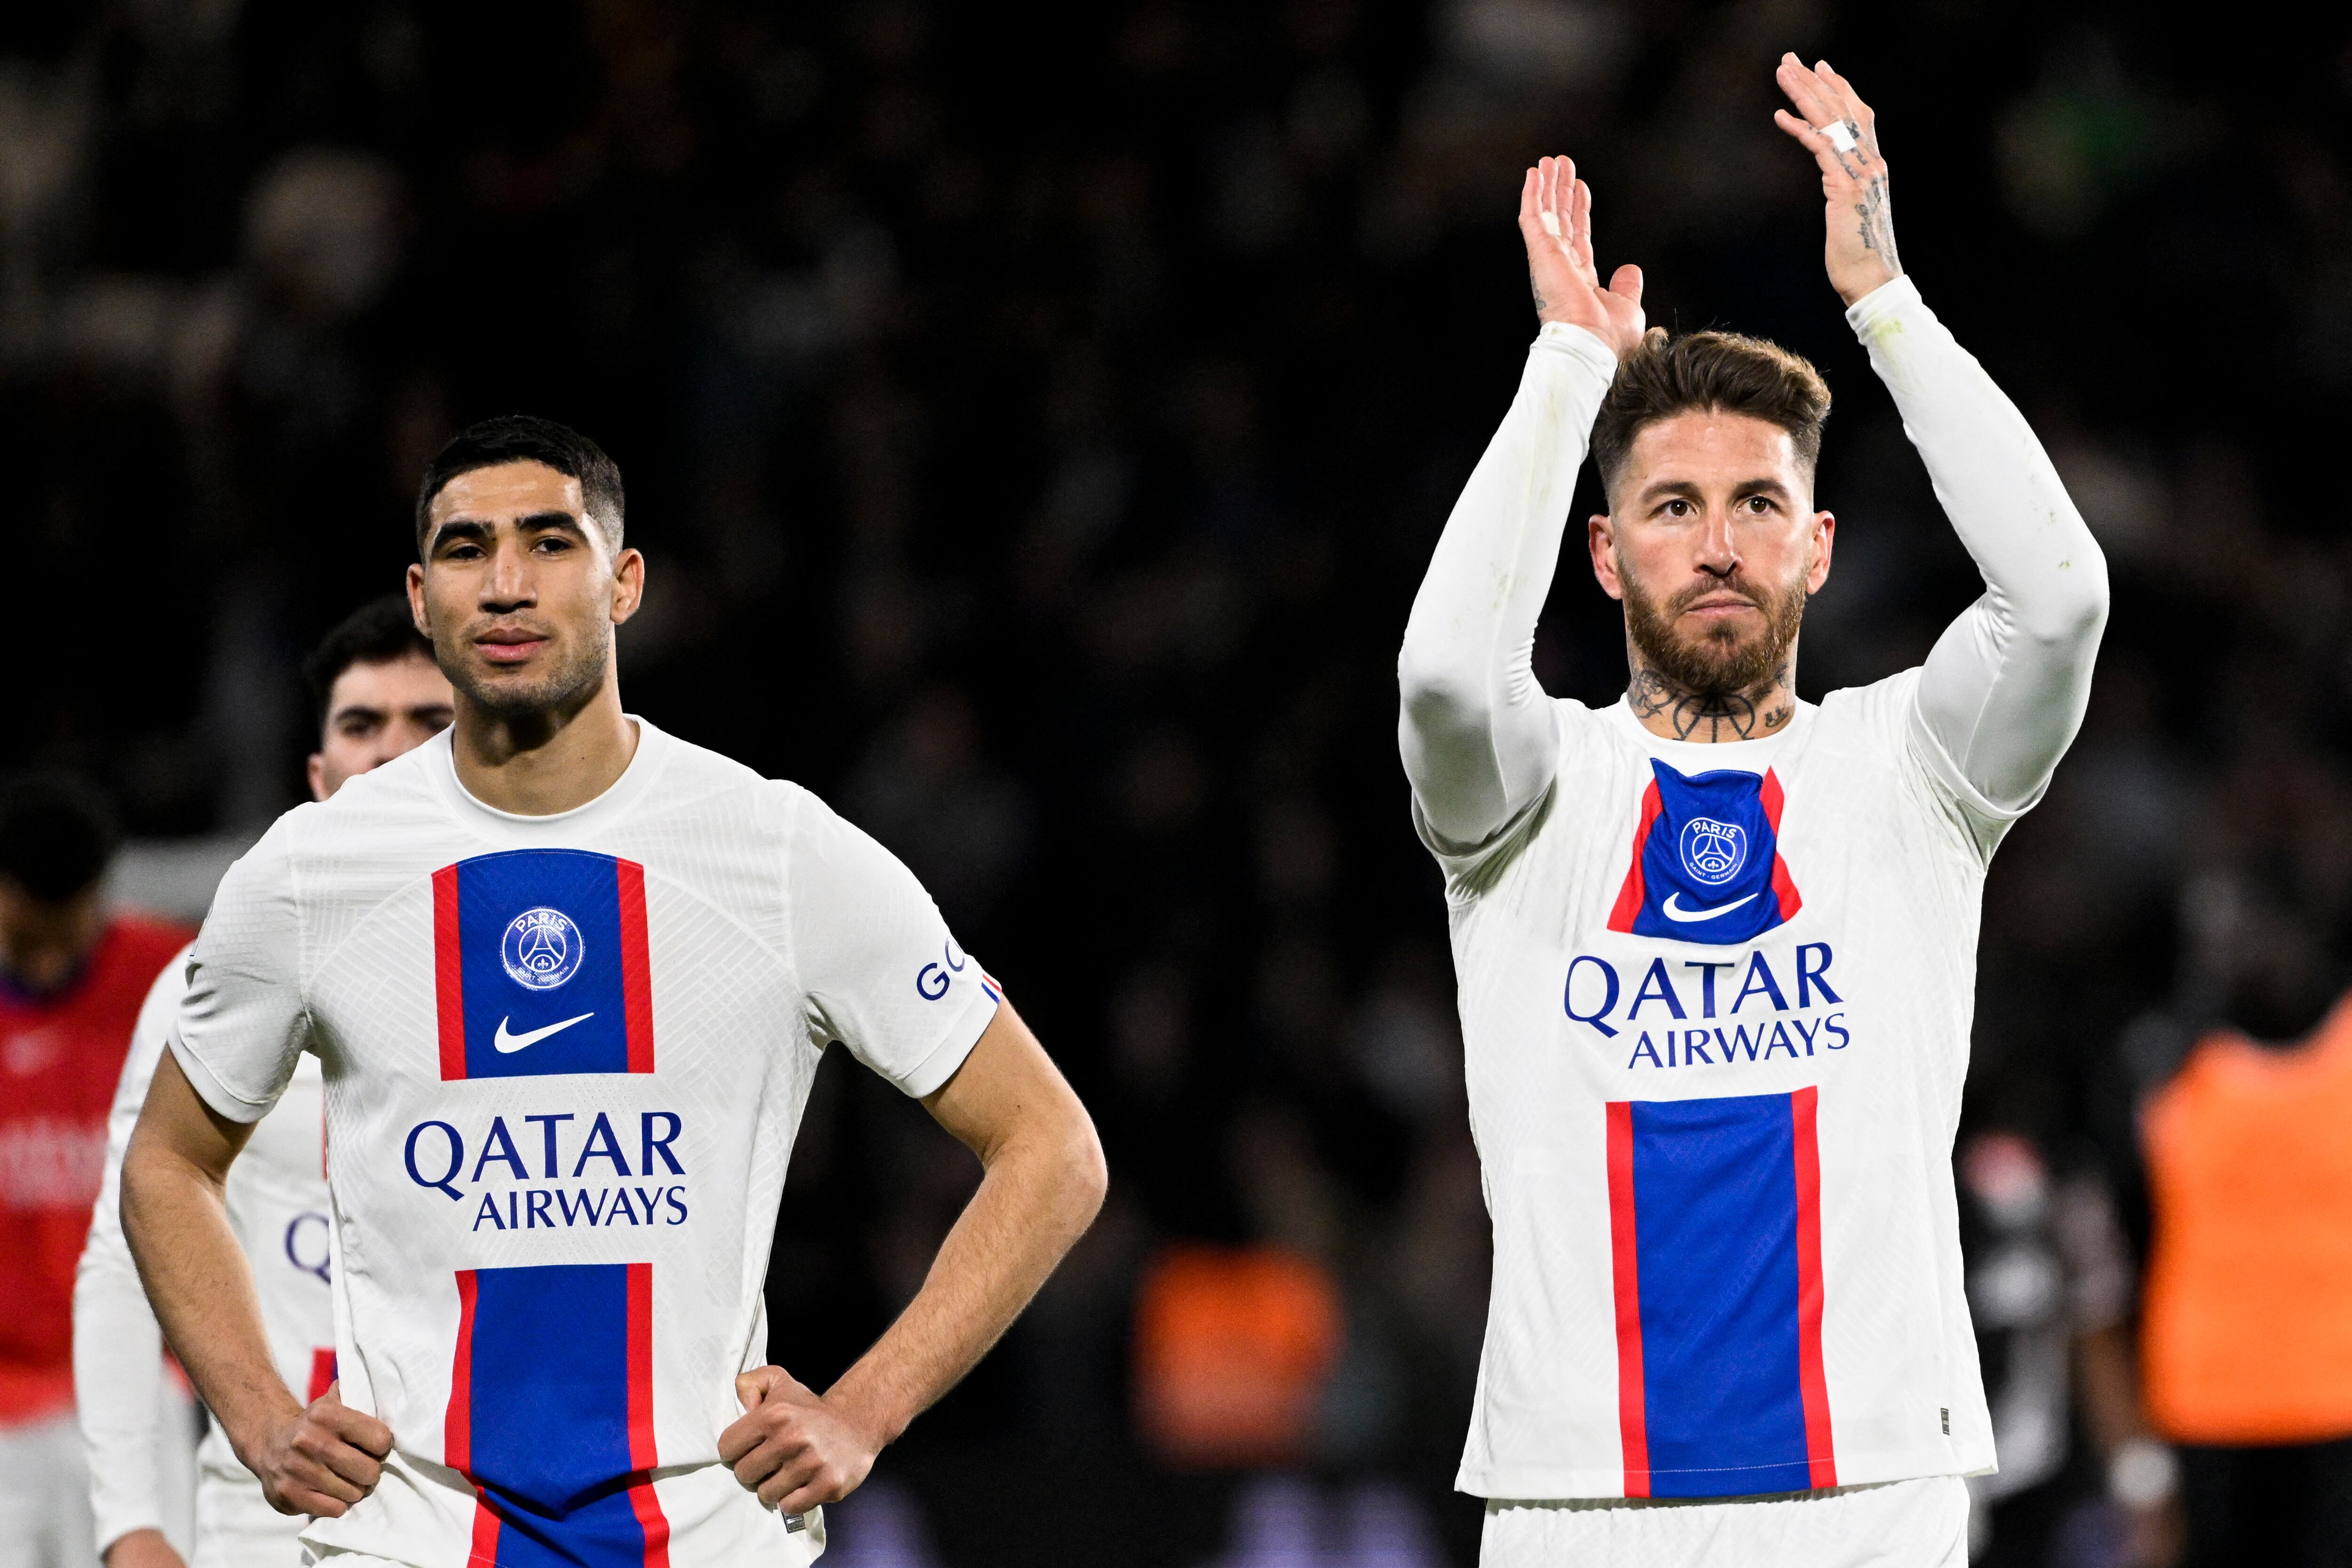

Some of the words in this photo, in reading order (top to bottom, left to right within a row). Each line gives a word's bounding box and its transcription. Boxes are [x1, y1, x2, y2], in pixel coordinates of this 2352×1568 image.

[1692, 821, 1737, 839] PARIS
[515, 912, 567, 933] PARIS
[1564, 942, 1844, 1038] QATAR
[1628, 1013, 1850, 1069] AIRWAYS
[404, 1111, 686, 1202] QATAR
[473, 1186, 688, 1232] AIRWAYS
